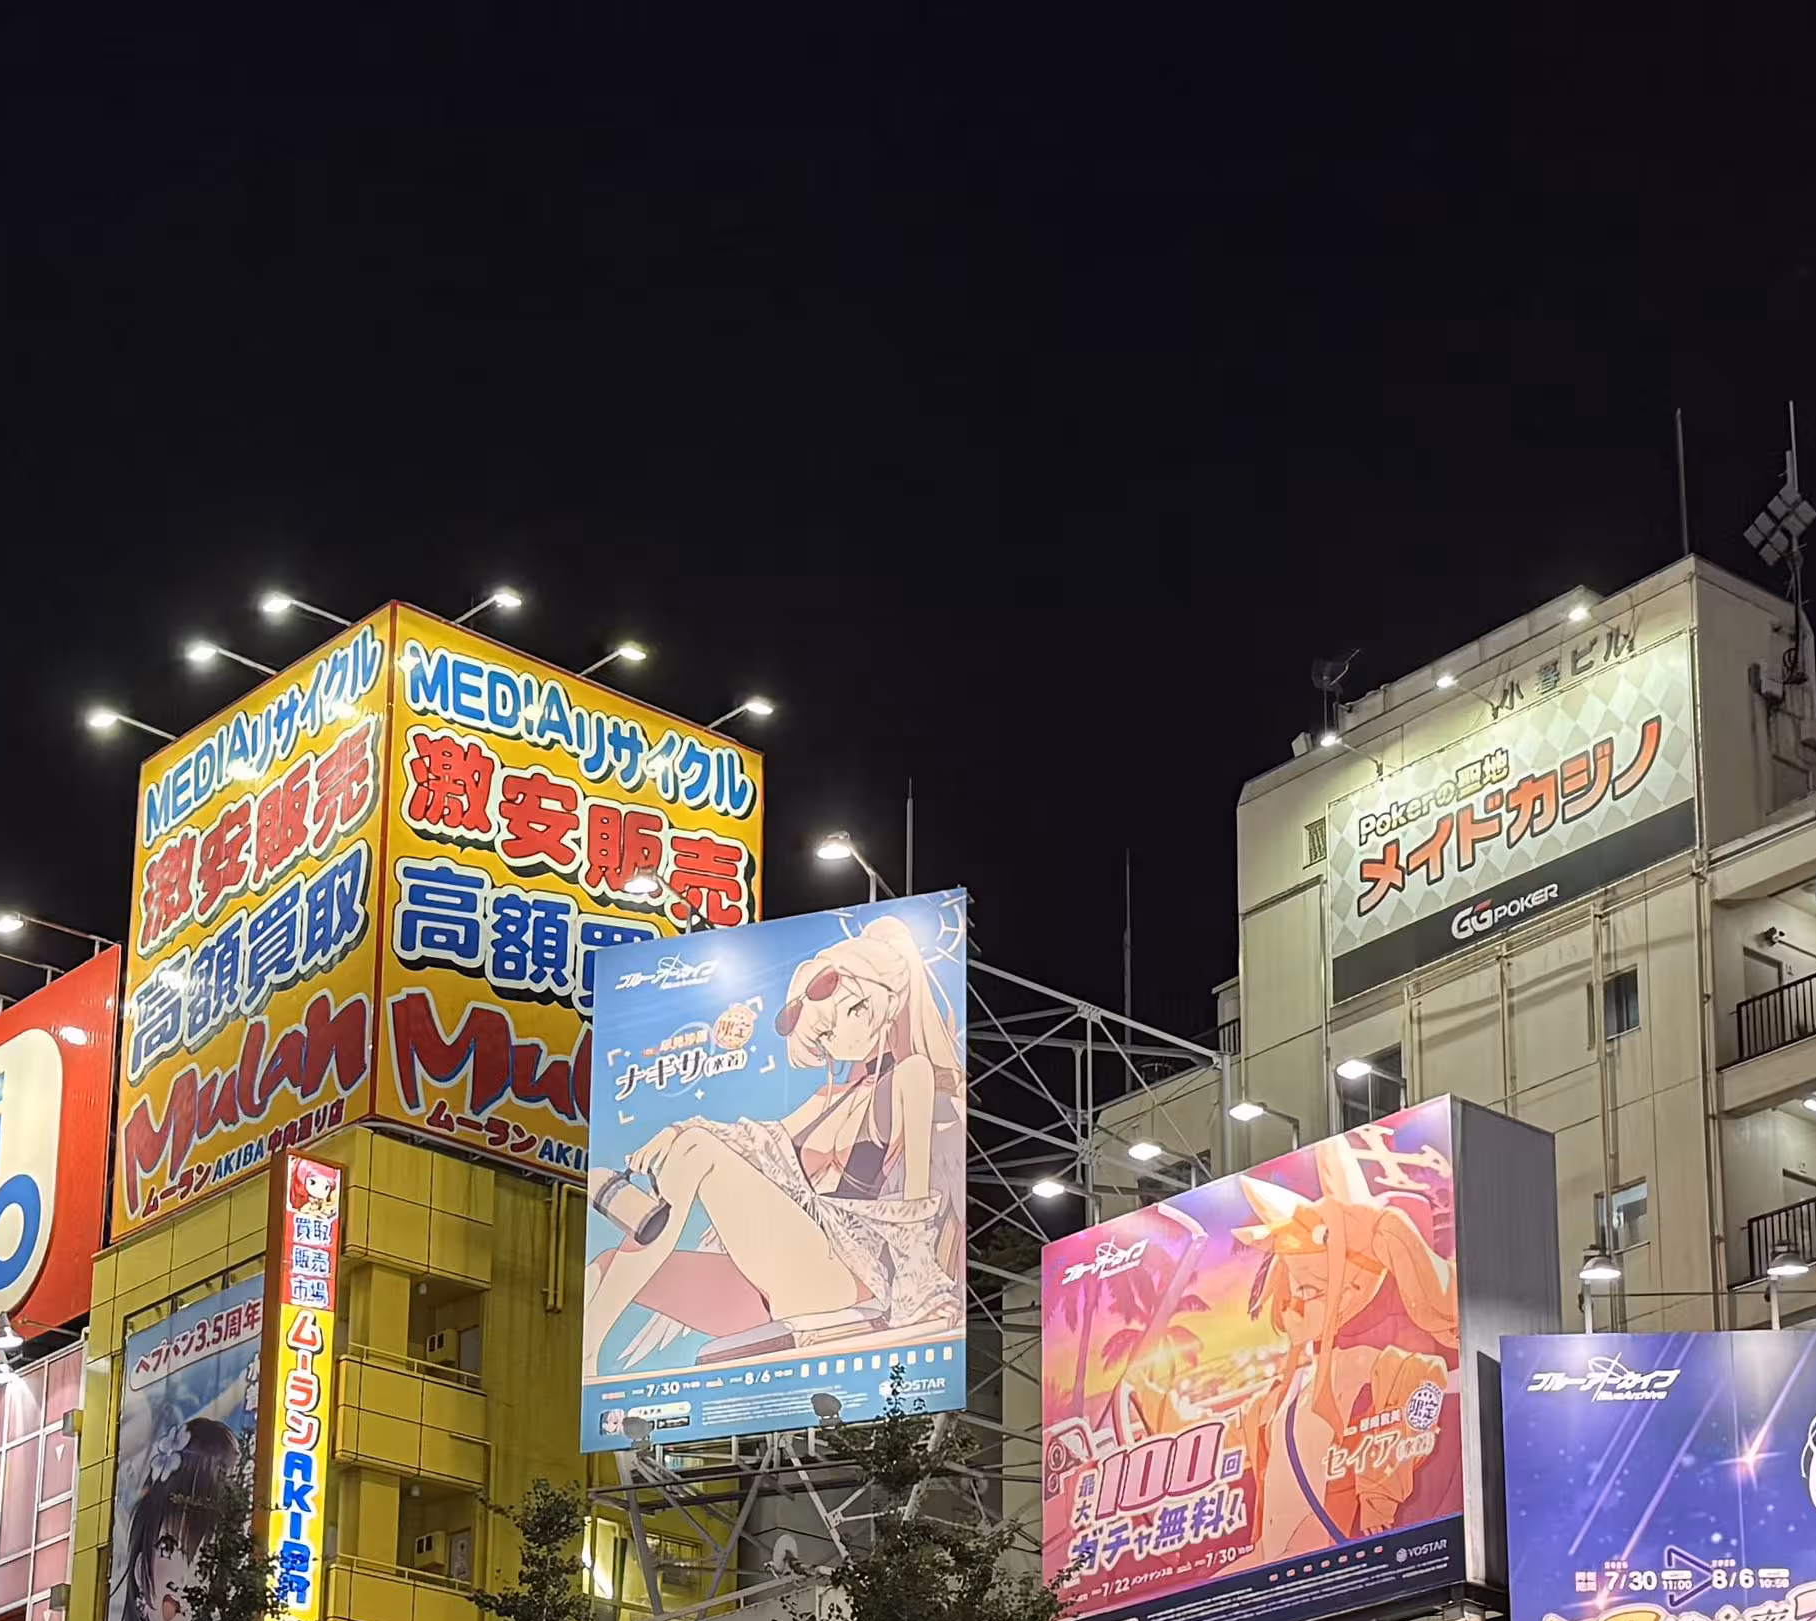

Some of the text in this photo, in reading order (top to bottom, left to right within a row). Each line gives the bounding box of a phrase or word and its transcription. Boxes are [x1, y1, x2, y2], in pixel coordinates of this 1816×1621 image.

[144, 629, 381, 842] MEDIAリサイクル
[404, 640, 753, 815] MEDIAリサイクル
[139, 718, 379, 956] 激安販売
[403, 728, 753, 932] 激安販売
[1356, 714, 1663, 918] メイドカジノ
[1359, 747, 1509, 847] Pokerの聖地
[130, 843, 370, 1079] 高額買取
[125, 989, 371, 1217] Mulan
[290, 1247, 331, 1276] 販売
[292, 1215, 333, 1245] 買取
[288, 1277, 329, 1306] 市場
[1094, 1421, 1225, 1521] 100
[1220, 1448, 1245, 1480] 回
[1407, 1538, 1448, 1559] YOSTAR
[1603, 1570, 1658, 1591] 7/30
[1711, 1568, 1756, 1589] 8/6
